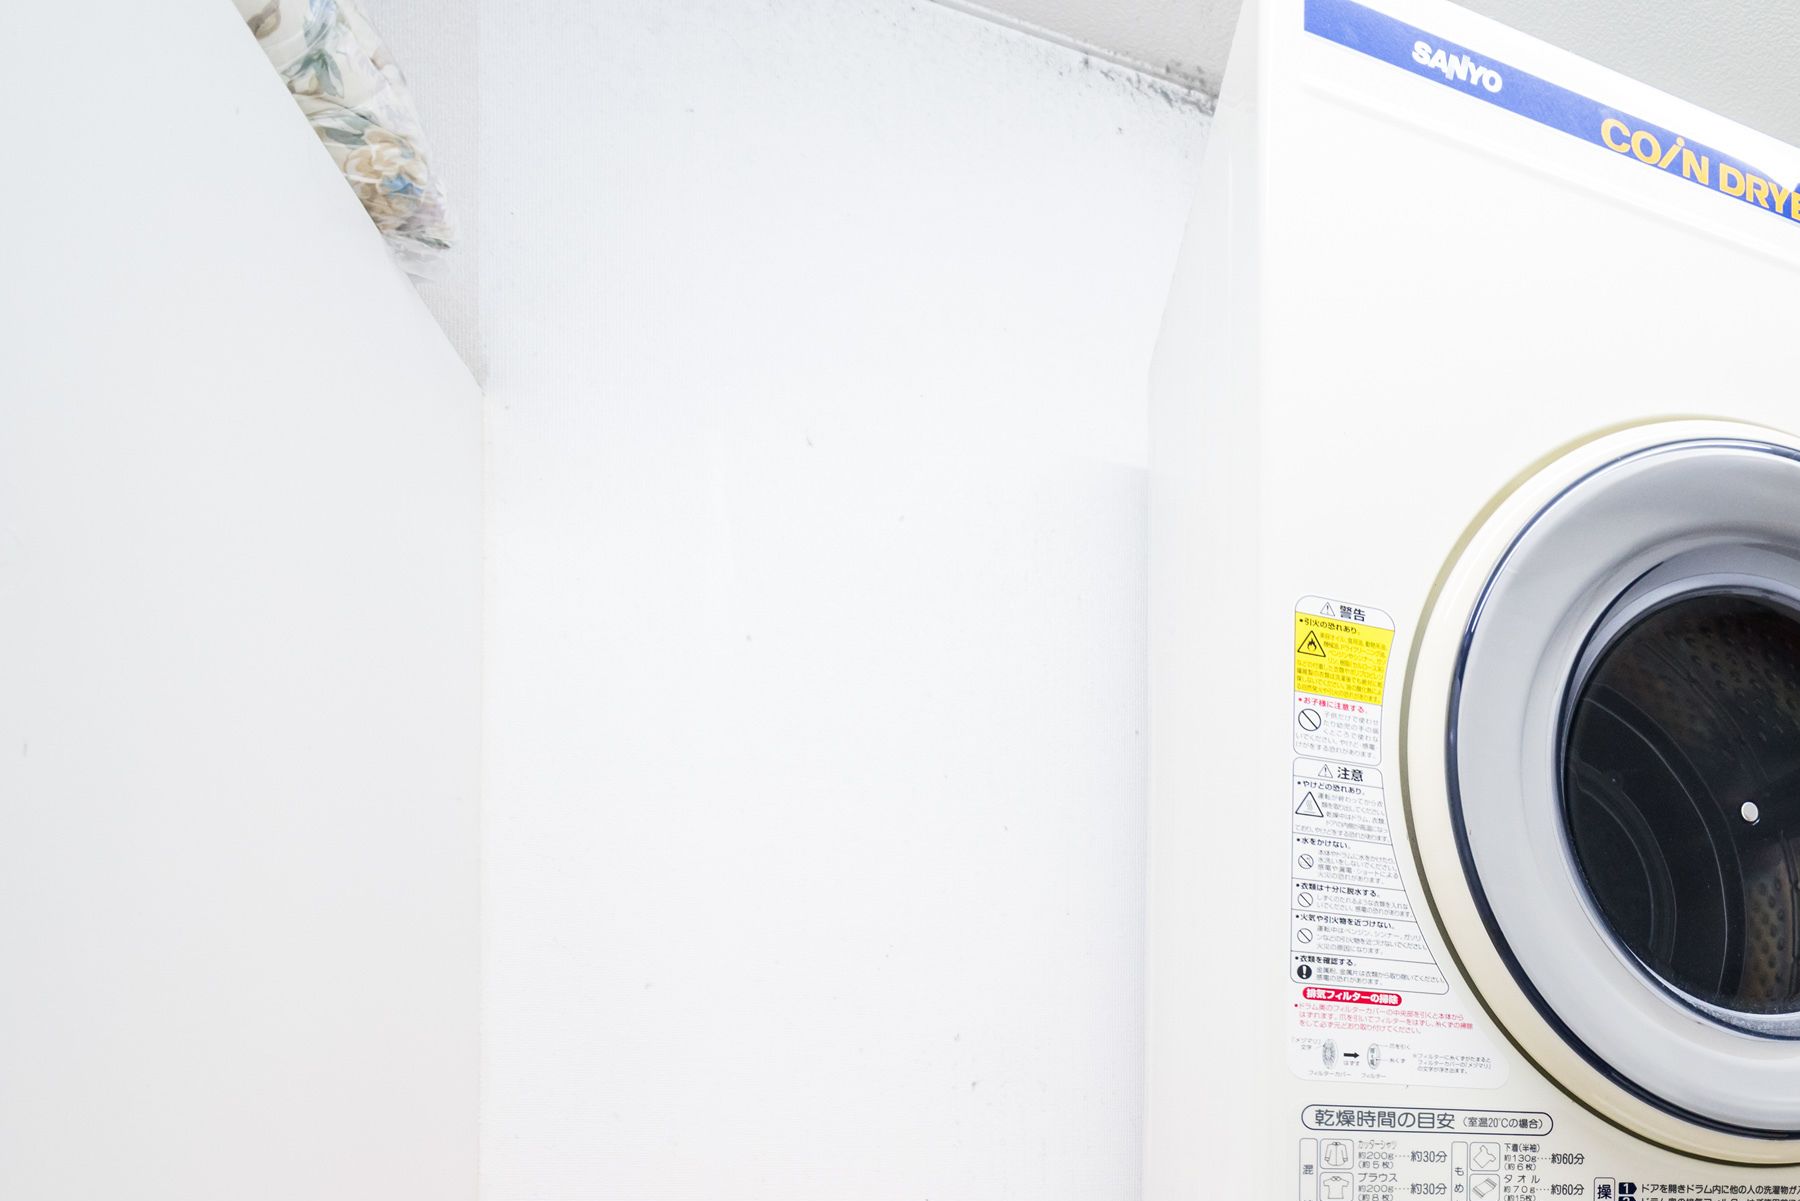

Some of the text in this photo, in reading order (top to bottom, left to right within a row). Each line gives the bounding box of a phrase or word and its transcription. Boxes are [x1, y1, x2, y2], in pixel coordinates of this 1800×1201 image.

[1411, 40, 1503, 94] SANYO
[1340, 605, 1366, 622] 警告
[1337, 766, 1363, 782] 注意
[1301, 883, 1379, 897] 衣類は十分に脱水する。
[1300, 955, 1356, 967] 衣類を確認する。
[1306, 988, 1399, 1004] 排気フィルターの掃除
[1315, 1109, 1455, 1131] 乾燥時間の目安
[1410, 1150, 1448, 1163] 約30分
[1551, 1153, 1585, 1165] 約60分
[1358, 1173, 1398, 1182] ブラウス
[1503, 1174, 1541, 1184] タオル
[1410, 1183, 1447, 1195] 約30分
[1551, 1184, 1584, 1196] 約60分
